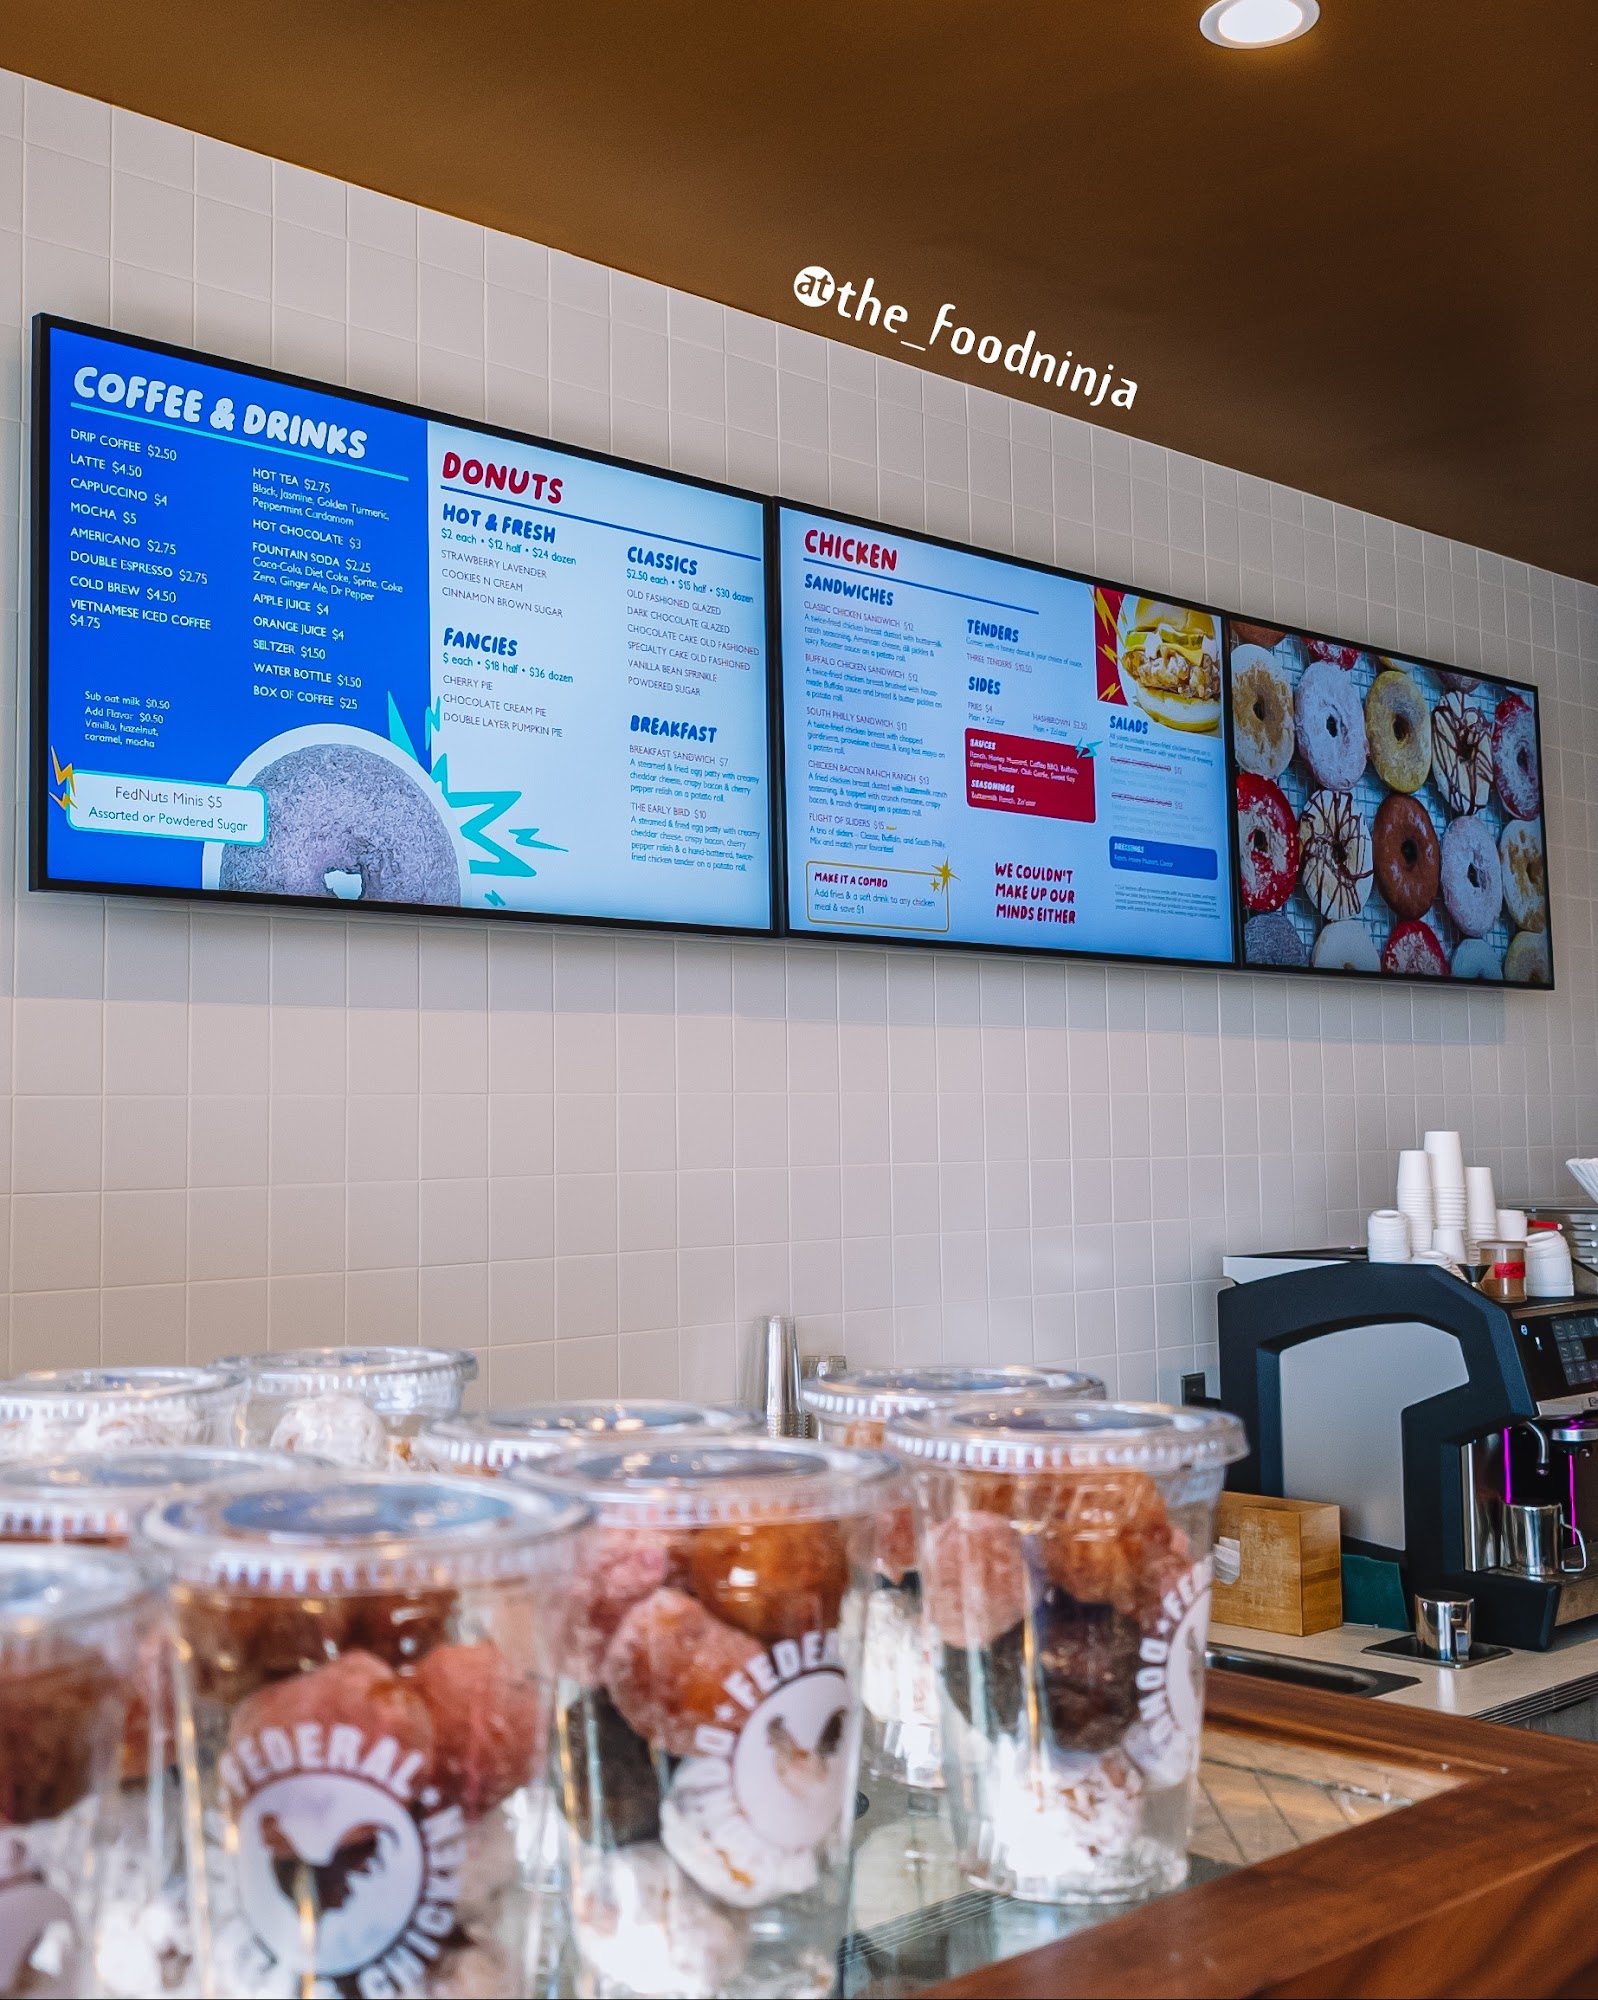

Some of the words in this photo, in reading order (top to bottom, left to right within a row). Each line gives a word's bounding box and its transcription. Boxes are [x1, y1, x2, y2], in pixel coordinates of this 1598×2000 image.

[74, 365, 203, 422] COFFEE
[209, 397, 235, 430] &
[243, 404, 367, 458] DRINKS
[71, 428, 96, 442] DRIP
[100, 435, 140, 452] COFFEE
[148, 444, 176, 461] $2.50
[70, 453, 105, 469] LATTE
[112, 461, 142, 477] $4.50
[442, 452, 562, 503] DONUTS
[70, 478, 147, 501] CAPPUCCINO
[154, 493, 167, 506] $4
[253, 467, 276, 481] HOT
[279, 473, 298, 486] TEA
[304, 478, 330, 493] $2.75
[71, 502, 116, 520] MOCHA
[123, 511, 136, 524] $5
[317, 496, 347, 511] Golden
[253, 519, 276, 531] HOT
[279, 524, 343, 545] CHOCOLATE
[349, 537, 360, 549] $3
[443, 503, 481, 527] HOT
[484, 513, 497, 531] &
[502, 516, 555, 543] FRESH
[70, 527, 140, 548] AMERICANO
[147, 539, 176, 554] $2.75
[441, 527, 452, 539] $2
[456, 534, 476, 544] each
[488, 537, 503, 550] $12
[506, 542, 522, 553] half
[532, 547, 548, 559] $24
[551, 552, 576, 565] dozen
[805, 529, 896, 570] CHICKEN
[71, 550, 117, 568] DOUBLE
[120, 559, 172, 577] ESPRESSO
[179, 569, 207, 584] $2.75
[253, 542, 307, 560] FOUNTAIN
[310, 552, 340, 566] SODA
[345, 558, 370, 572] $2.25
[441, 549, 500, 568] STRAWBERRY
[502, 562, 546, 578] LAVENDER
[627, 546, 697, 575] CLASSICS
[70, 576, 103, 590] COLD
[108, 582, 139, 595] BREW
[147, 588, 176, 602] $4.50
[280, 575, 310, 590] Ginger
[331, 585, 342, 594] Dr
[345, 587, 374, 601] Pepper
[442, 568, 480, 583] COOKIES
[483, 576, 490, 585] N
[493, 578, 522, 592] CREAM
[626, 568, 647, 581] $2.50
[650, 576, 668, 585] each
[678, 579, 690, 590] $15
[693, 582, 706, 593] half
[716, 587, 729, 598] $30
[732, 591, 754, 603] dozen
[804, 573, 893, 606] SANDWICHES
[70, 599, 138, 618] VIETNAMESE
[142, 610, 167, 622] ICED
[171, 614, 210, 629] COFFEE
[253, 593, 283, 606] APPLE
[286, 598, 310, 611] JUICE
[316, 603, 328, 615] $4
[442, 587, 494, 604] CINNAMON
[497, 597, 531, 611] BROWN
[534, 604, 562, 617] SUGAR
[627, 589, 643, 599] OLD
[646, 592, 689, 608] FASHIONED
[692, 602, 721, 615] GLAZED
[70, 613, 100, 629] $4.75
[253, 616, 298, 632] ORANGE
[301, 624, 326, 637] JUICE
[332, 628, 344, 641] $4
[967, 619, 1018, 642] TENDERS
[253, 639, 295, 654] SELTZER
[444, 627, 517, 656] FANCIES
[254, 663, 291, 676] WATER
[294, 668, 331, 682] BOTTLE
[443, 652, 448, 664] $
[452, 656, 473, 666] each
[485, 659, 499, 670] $18
[502, 662, 518, 673] half
[529, 666, 545, 678] $36
[548, 670, 573, 682] dozen
[443, 674, 478, 687] CHERRY
[481, 680, 492, 690] PIE
[628, 676, 672, 691] POWDERED
[675, 684, 700, 695] SUGAR
[968, 676, 1000, 695] SIDES
[85, 690, 101, 701] Sub
[122, 696, 140, 706] milk
[146, 698, 169, 709] $0.50
[253, 685, 277, 697] BOX
[280, 689, 293, 699] OF
[297, 691, 333, 705] COFFEE
[340, 697, 357, 709] $25
[443, 693, 499, 710] CHOCOLATE
[503, 702, 532, 714] CREAM
[535, 707, 546, 717] PIE
[84, 706, 104, 716] Add
[106, 708, 133, 719] Flavor
[139, 712, 163, 723] $0.50
[444, 712, 480, 725] DOUBLE
[482, 718, 510, 729] LAYER
[512, 722, 549, 735] PUMPKIN
[552, 727, 562, 737] PIE
[1110, 715, 1148, 734] SALADS
[630, 715, 717, 743] BREAKFAST
[126, 738, 154, 747] mocha
[970, 738, 996, 750] SAUCES
[116, 786, 168, 802] FedNuts
[174, 792, 203, 806] Minis
[208, 795, 222, 808] $5
[971, 779, 1014, 793] SEASONINGS
[88, 806, 138, 821] Assorted
[142, 814, 155, 822] or
[159, 813, 213, 828] Powdered
[217, 818, 247, 833] Sugar
[809, 812, 832, 822] FLIGHT
[845, 817, 870, 827] SLIDERS
[814, 872, 838, 883] MAKE
[840, 875, 848, 884] IT
[850, 876, 855, 884] A
[858, 876, 887, 887] COMBO
[995, 862, 1012, 878] WE
[1016, 864, 1072, 883] COULDN'T
[995, 883, 1027, 900] MAKE
[1031, 887, 1046, 900] UP
[1050, 889, 1074, 904] OUR
[996, 904, 1034, 920] MINDS
[1037, 907, 1075, 924] EITHER
[217, 1722, 426, 1802] FEDERAL
